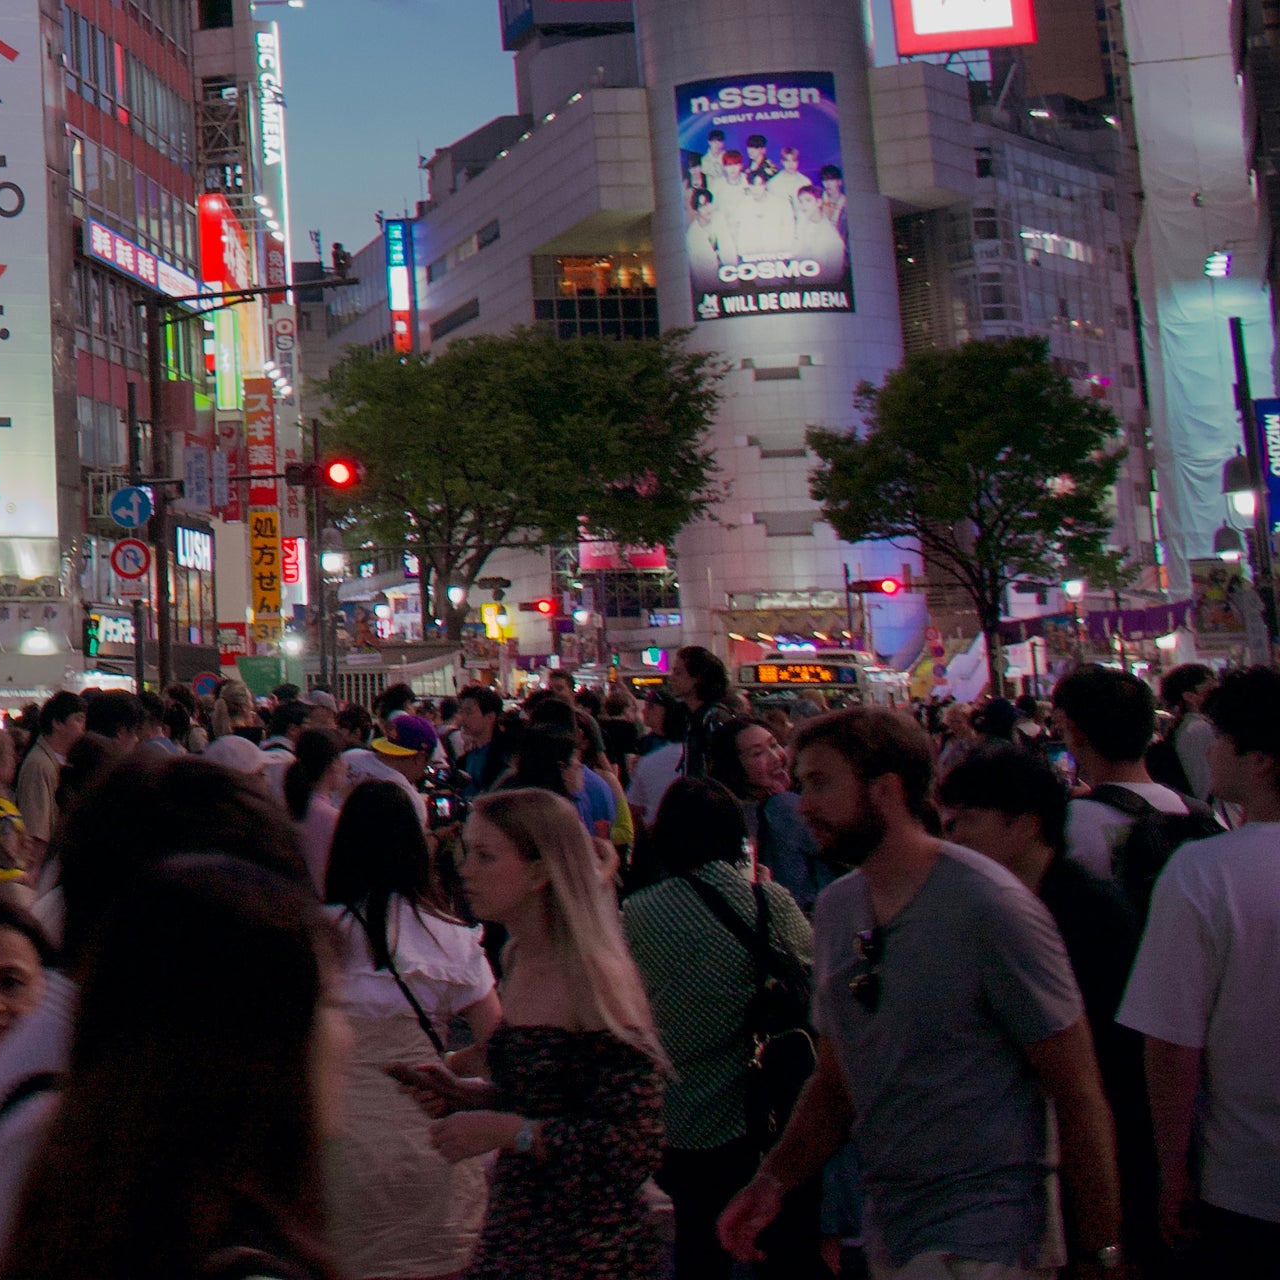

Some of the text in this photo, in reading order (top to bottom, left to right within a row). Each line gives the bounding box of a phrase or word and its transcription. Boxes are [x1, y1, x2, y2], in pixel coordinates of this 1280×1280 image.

[255, 32, 284, 166] BIC CAMERA
[691, 83, 821, 114] n.SSign
[713, 110, 800, 125] DEBUT ALBUM
[718, 260, 821, 282] COSMO
[723, 293, 758, 314] WILL
[759, 293, 779, 310] BE
[782, 292, 801, 309] ON
[803, 290, 848, 309] ABEMA
[276, 318, 295, 351] OS
[247, 393, 275, 490] スギ薬局
[176, 526, 214, 572] LUSH
